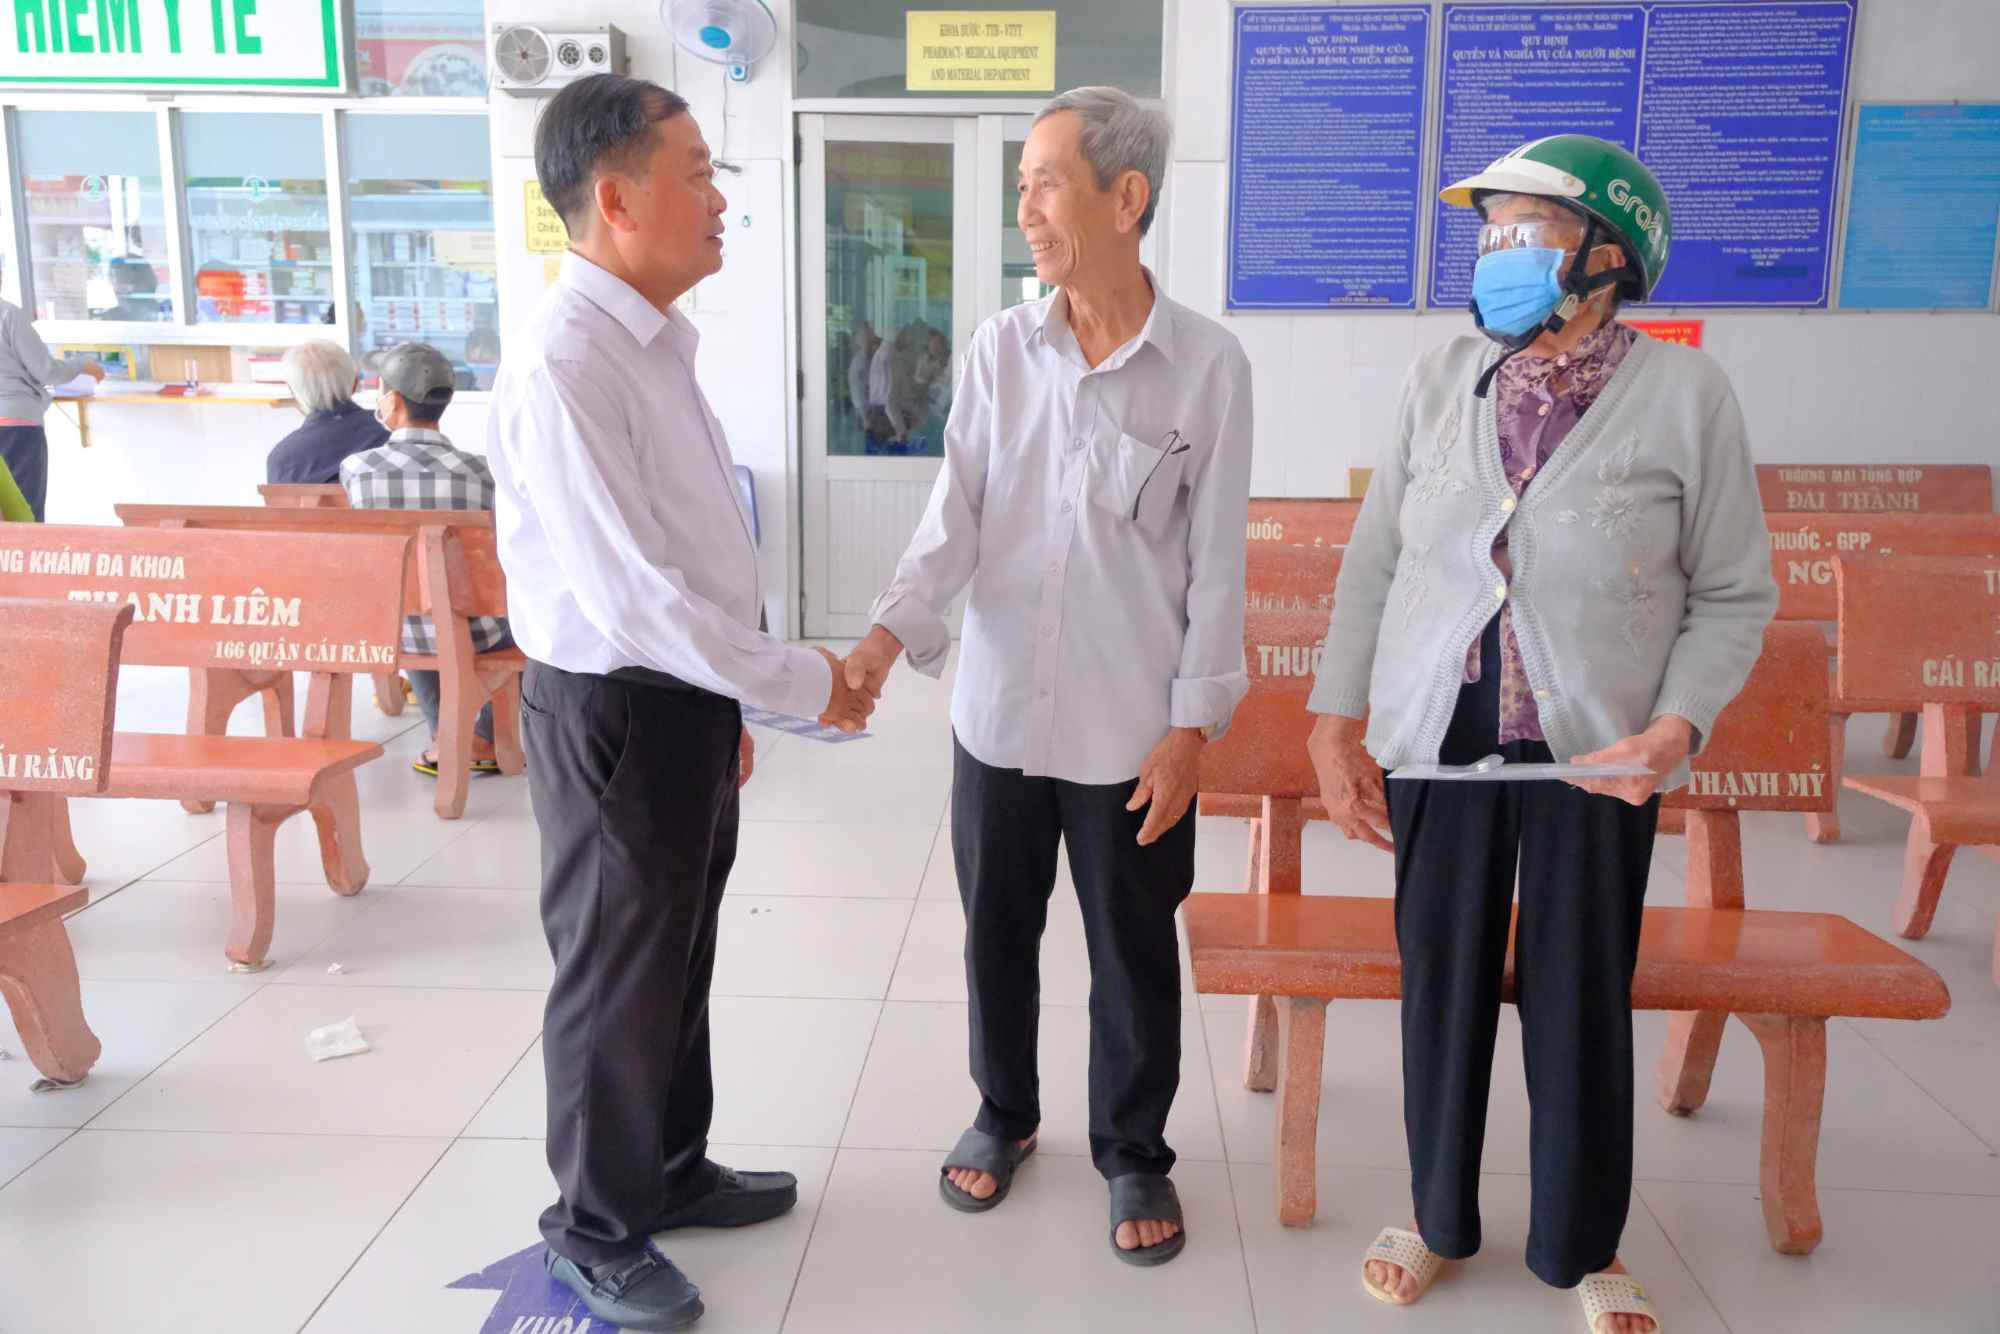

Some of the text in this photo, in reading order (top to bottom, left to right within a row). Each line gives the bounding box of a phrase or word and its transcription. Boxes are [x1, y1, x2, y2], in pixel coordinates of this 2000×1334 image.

[965, 46, 996, 59] MEDICAL
[998, 46, 1040, 61] EQUIPMENT
[1522, 35, 1541, 47] QUY
[931, 68, 1031, 81] AND MATERIAL DEPARTMENT
[1837, 531, 1871, 551] GPP
[29, 546, 92, 577] KHÁM
[96, 553, 124, 577] ĐA
[130, 555, 186, 579] KHOA
[209, 587, 302, 627] LIÊM
[215, 636, 396, 668] 166 QUẬN CÁI RĂNG
[1922, 654, 1965, 688] CÁI
[24, 747, 95, 781] RĂNG
[1688, 763, 1825, 807] THẠNH MỸ
